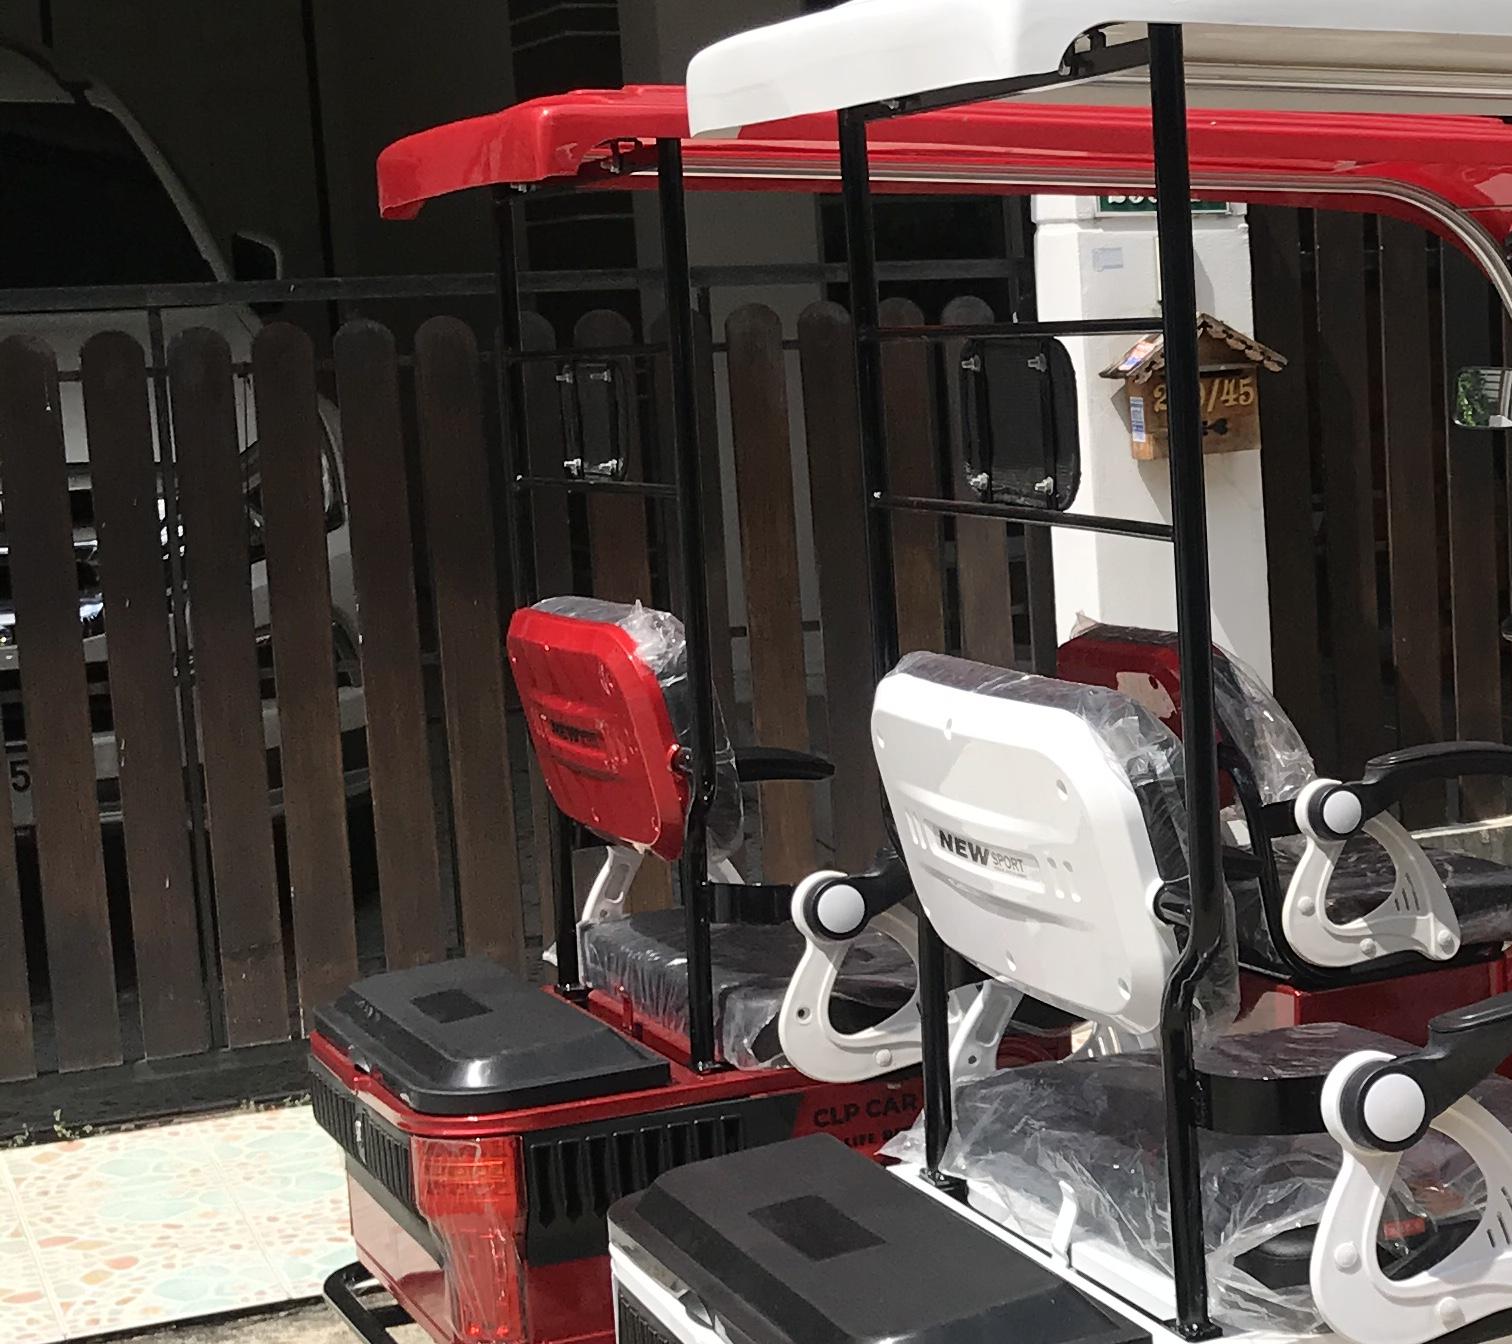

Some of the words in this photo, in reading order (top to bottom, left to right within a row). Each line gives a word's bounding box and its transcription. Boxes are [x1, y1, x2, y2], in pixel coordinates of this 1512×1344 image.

[1153, 377, 1254, 413] 2/45
[939, 829, 990, 866] NEW
[991, 851, 1024, 872] SPORT
[813, 1103, 860, 1127] CLP
[866, 1093, 917, 1118] CAR
